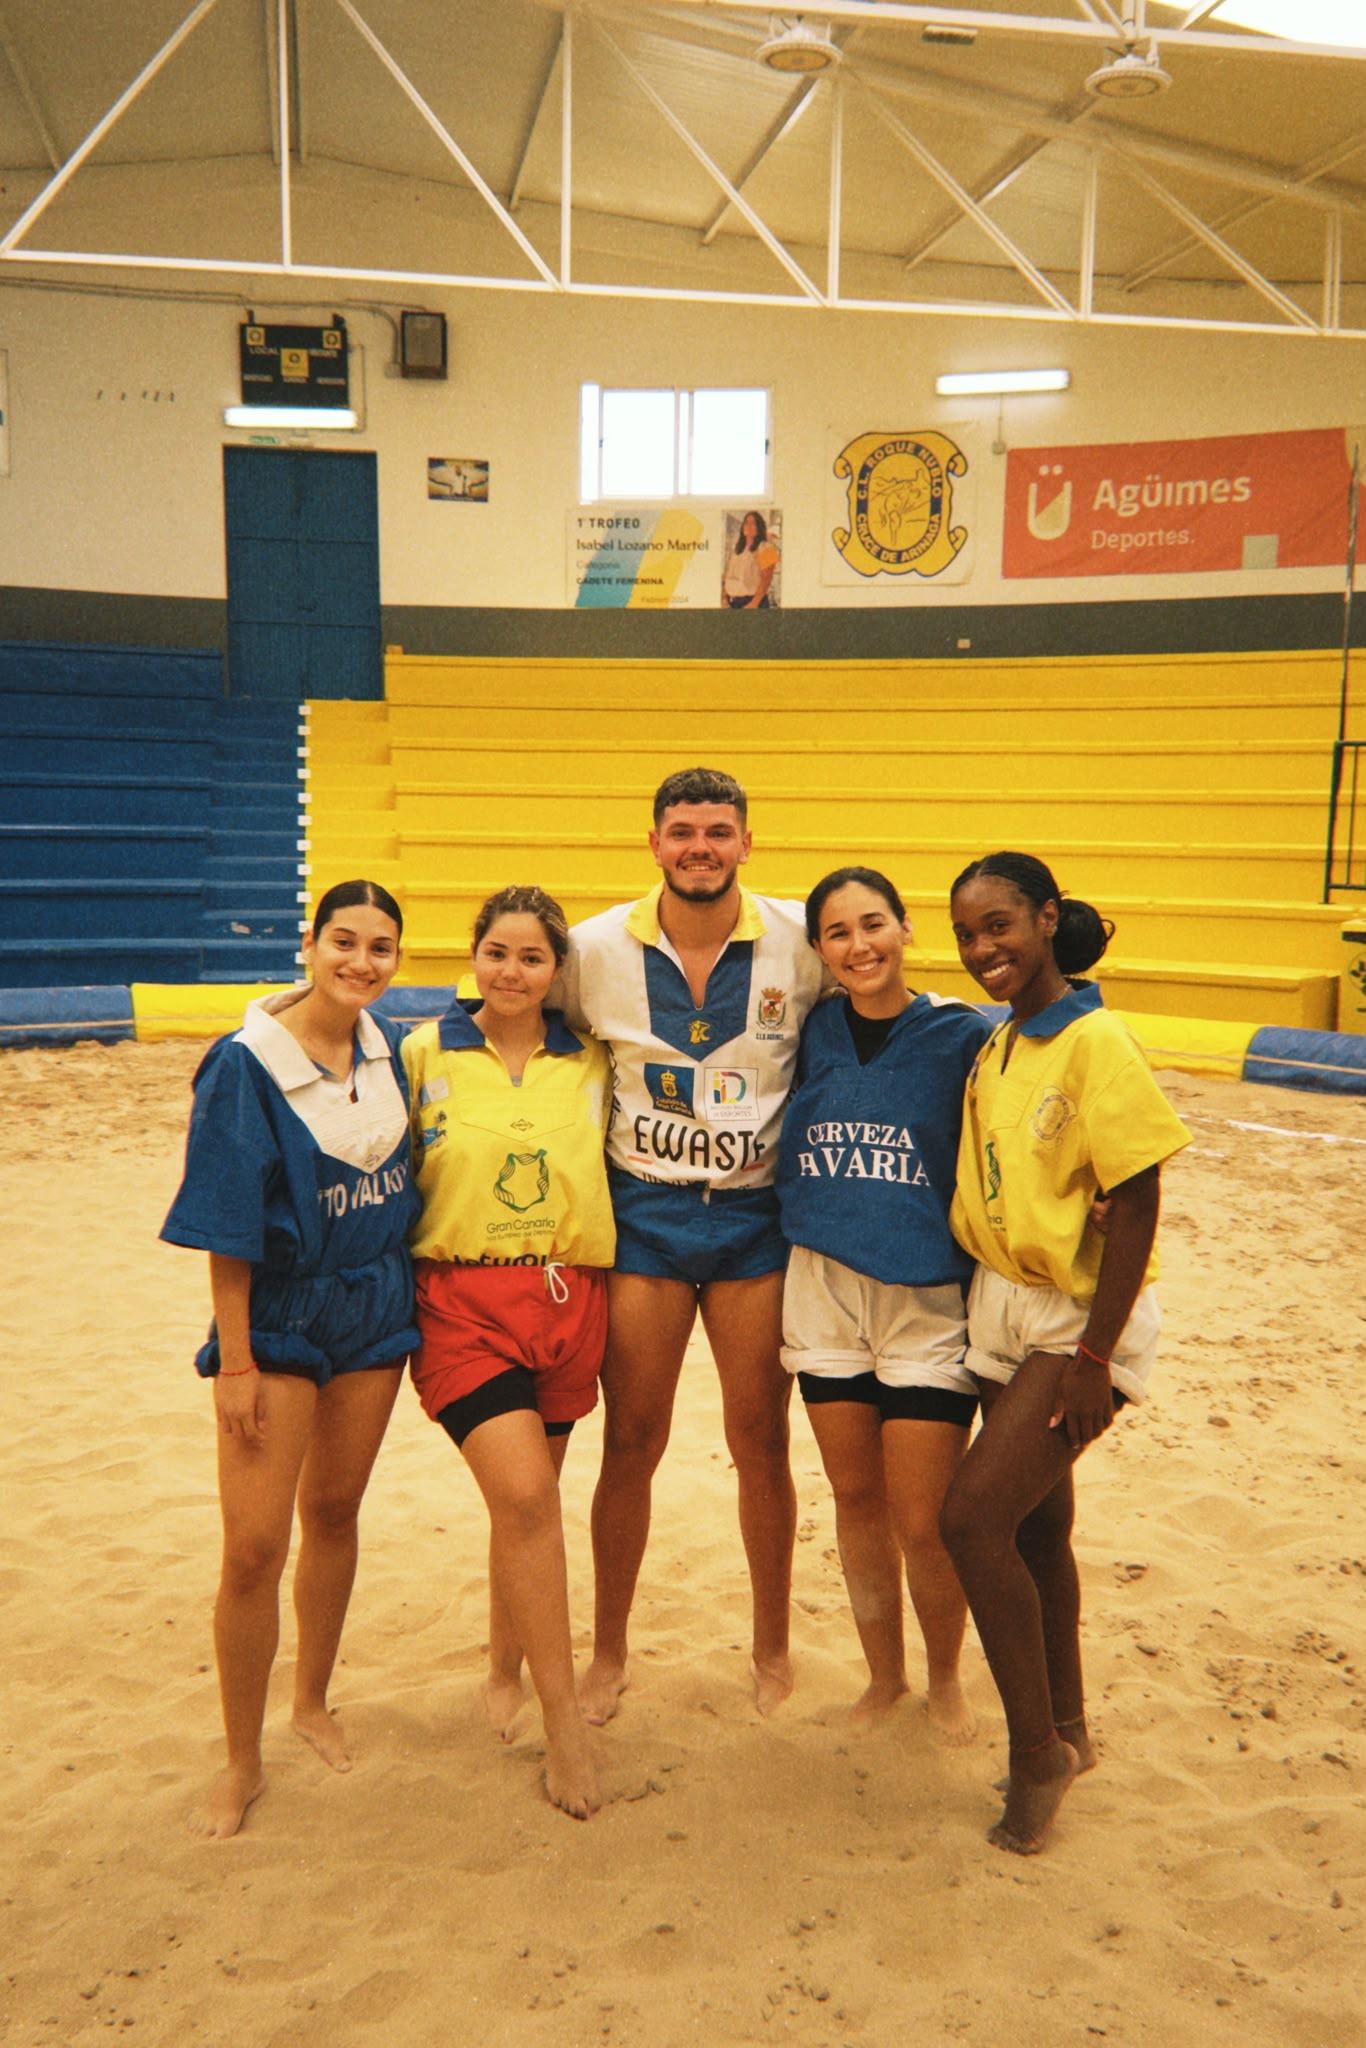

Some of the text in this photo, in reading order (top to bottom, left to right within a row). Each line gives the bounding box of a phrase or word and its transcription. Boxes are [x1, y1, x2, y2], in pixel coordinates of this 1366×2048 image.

[867, 441, 917, 468] ROQUE
[919, 449, 943, 499] NUBLO
[589, 518, 641, 529] TROFEO
[576, 539, 709, 551] Isabel Lozano Martel
[857, 513, 941, 563] CRUCE DE ARINAGA
[486, 1222, 512, 1235] Gran
[513, 1217, 556, 1231] Canaria
